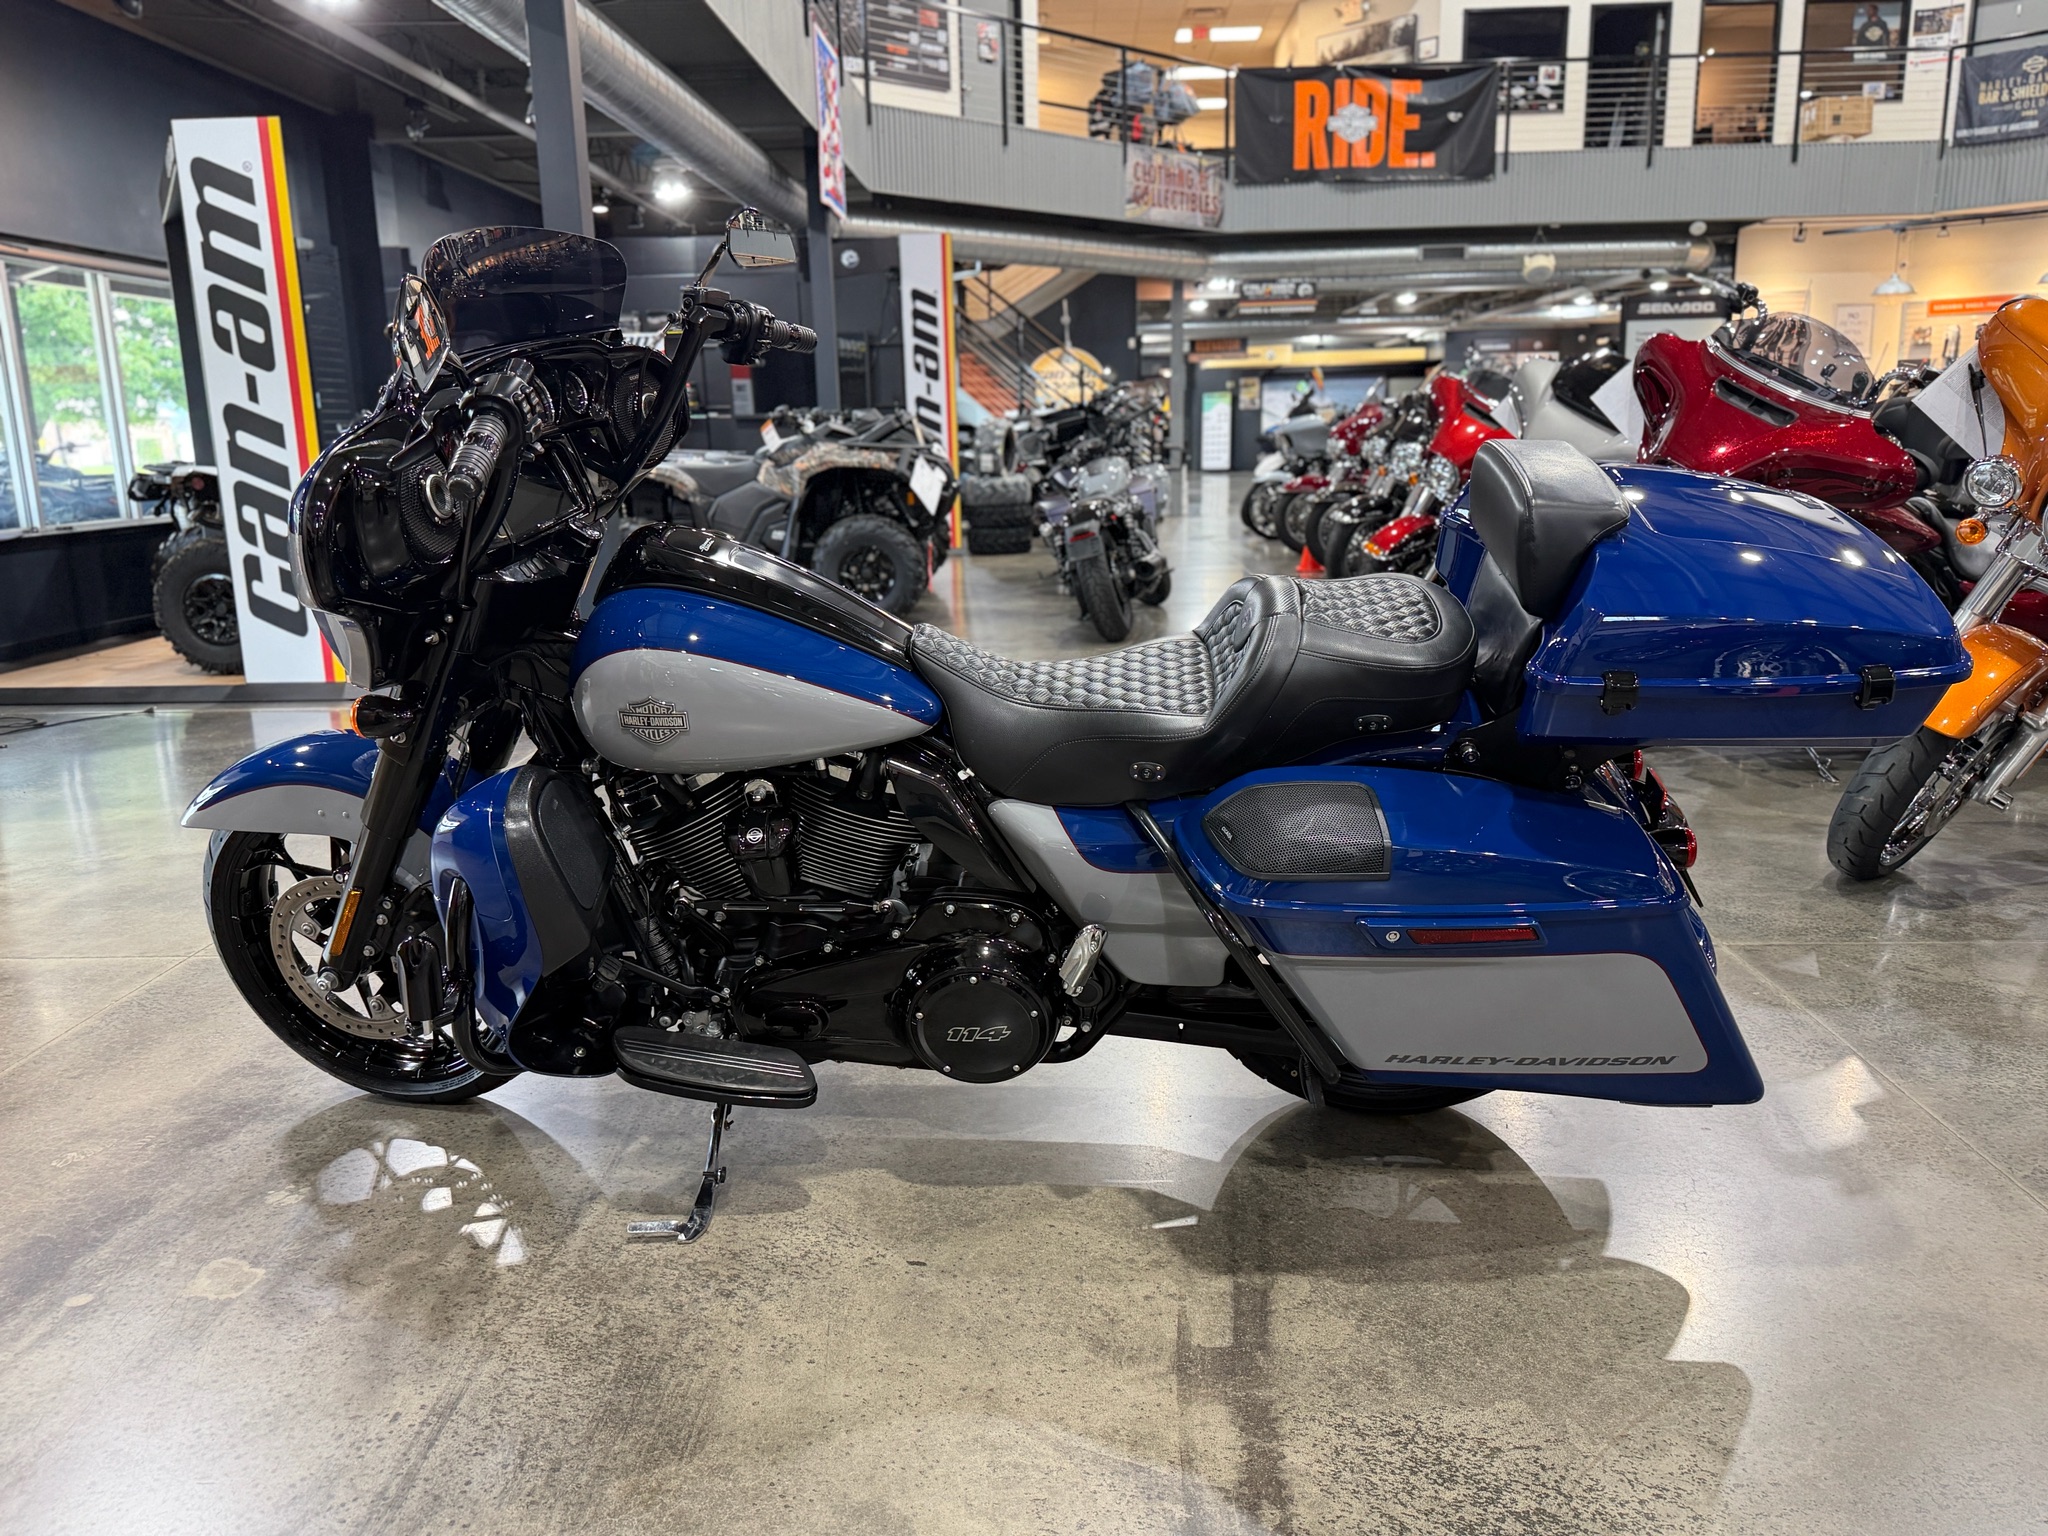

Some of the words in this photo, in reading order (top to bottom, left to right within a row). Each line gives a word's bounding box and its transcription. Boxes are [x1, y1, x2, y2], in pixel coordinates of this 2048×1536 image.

[1978, 90, 2000, 105] BAR
[2001, 88, 2010, 102] &
[636, 704, 669, 714] MOTOR
[623, 715, 683, 727] HARLEY-DAVIDSON
[640, 729, 671, 740] CYCLES
[946, 1025, 1012, 1042] 114
[1385, 1054, 1678, 1067] HARLEY-DAVIDSON
